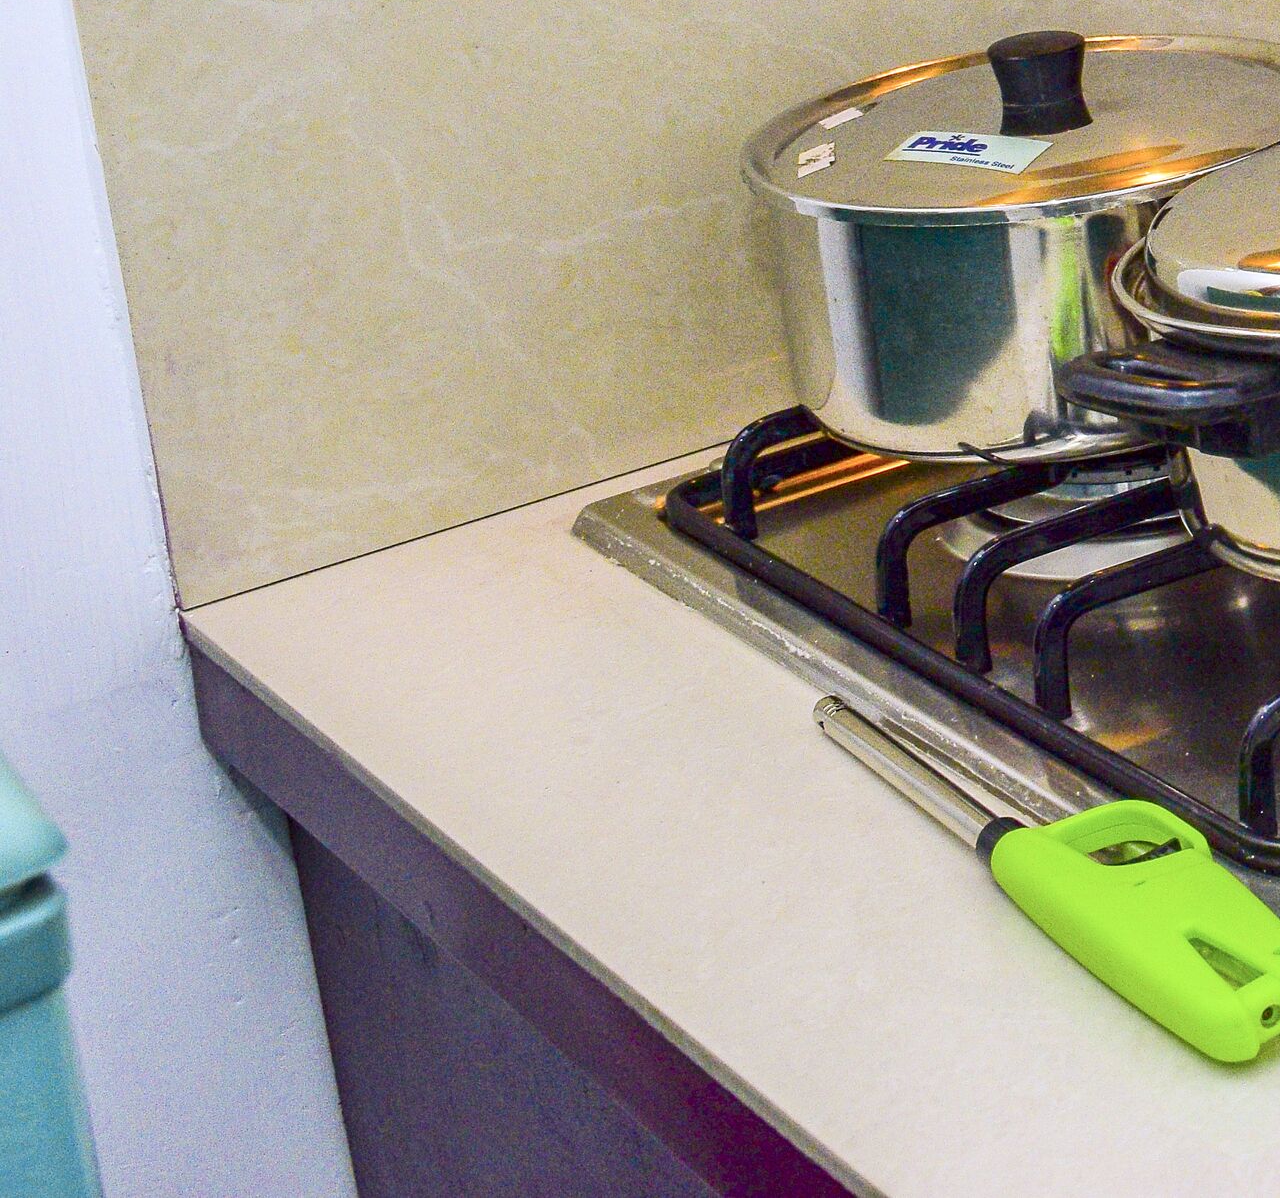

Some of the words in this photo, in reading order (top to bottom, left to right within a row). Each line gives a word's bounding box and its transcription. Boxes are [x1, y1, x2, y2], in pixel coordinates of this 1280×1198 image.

[907, 135, 988, 153] Pride
[949, 156, 990, 166] Stainless
[991, 161, 1015, 170] Steel
